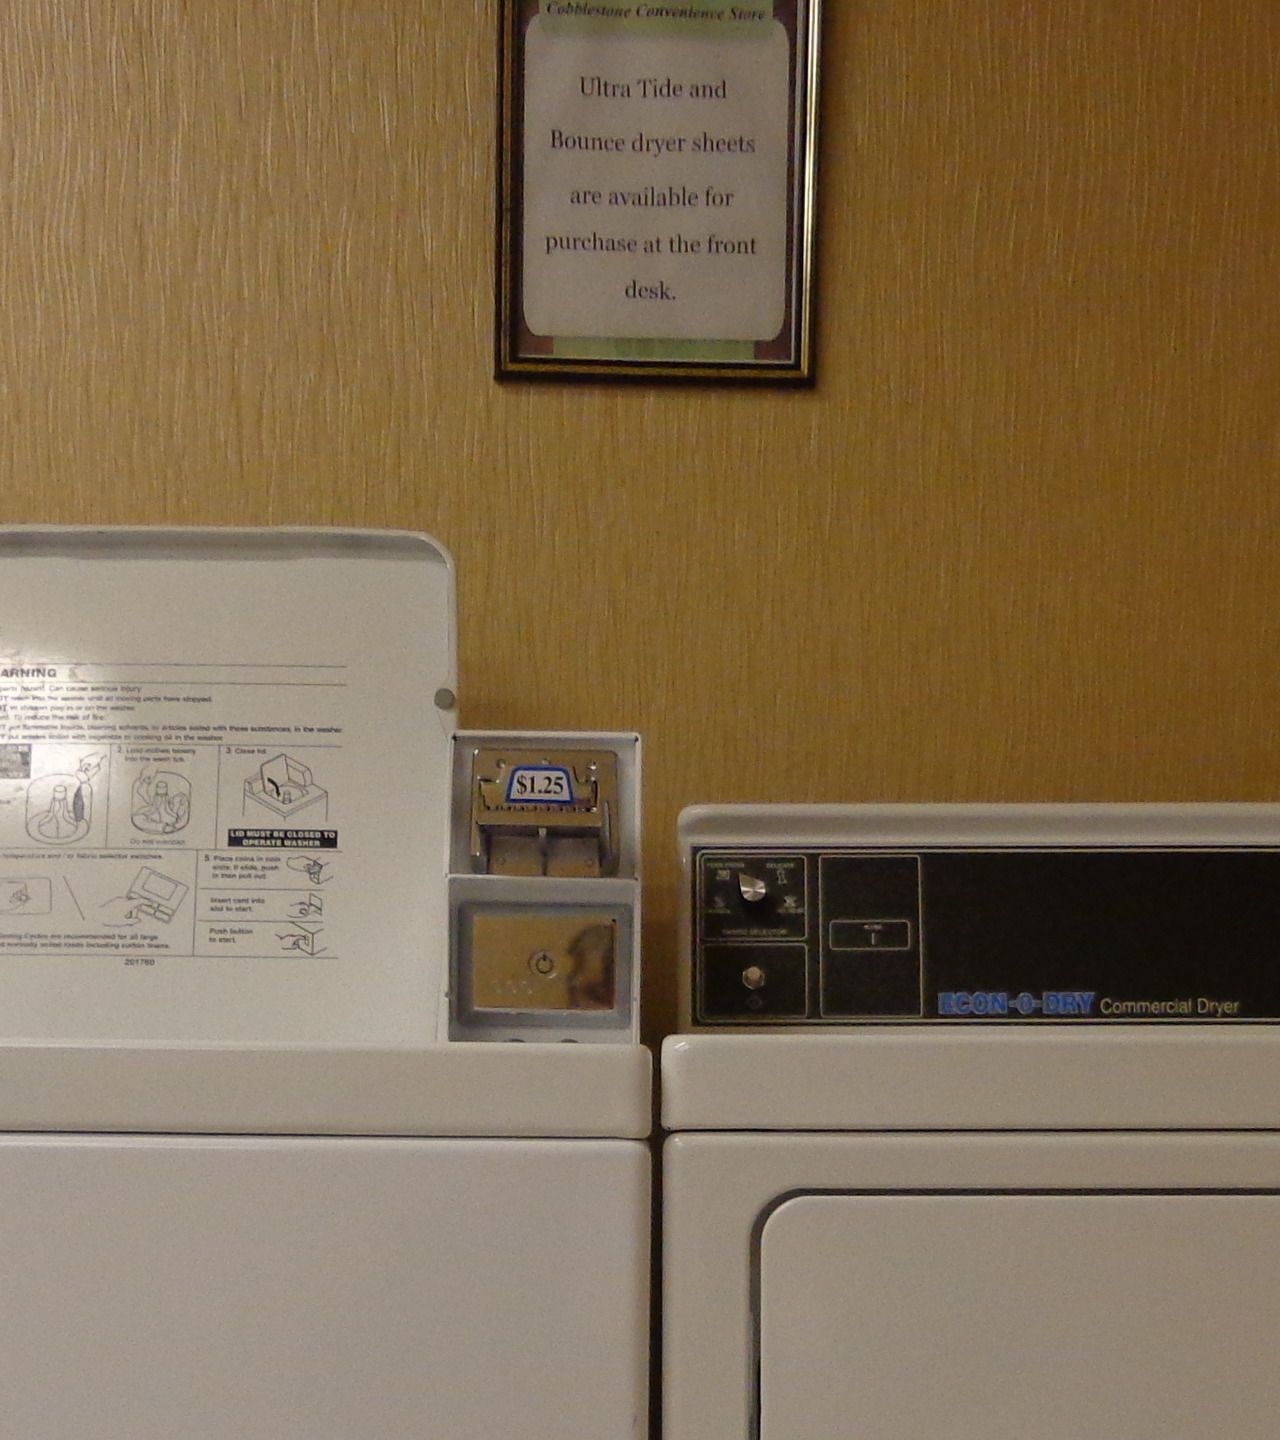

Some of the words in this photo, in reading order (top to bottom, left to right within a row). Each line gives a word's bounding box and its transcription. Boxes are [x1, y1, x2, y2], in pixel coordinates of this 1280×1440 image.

[546, 2, 632, 18] Cobblestone
[636, 4, 726, 20] Convenience
[729, 6, 766, 22] Store
[579, 76, 632, 100] Ultra
[637, 78, 684, 100] Tide
[689, 80, 728, 100] and
[550, 129, 626, 152] Bounce
[631, 132, 686, 158] dryer
[692, 133, 756, 154] sheets
[570, 189, 602, 206] are
[608, 186, 700, 208] available
[704, 187, 734, 208] for
[545, 232, 638, 256] purchase
[643, 237, 664, 254] at
[669, 234, 702, 254] the
[707, 235, 756, 256] front
[624, 279, 678, 302] desk.
[516, 774, 564, 796] $1.25
[938, 992, 1096, 1014] ECON-O-DRY
[1100, 998, 1192, 1014] Commercial
[1198, 998, 1240, 1018] Dryer
